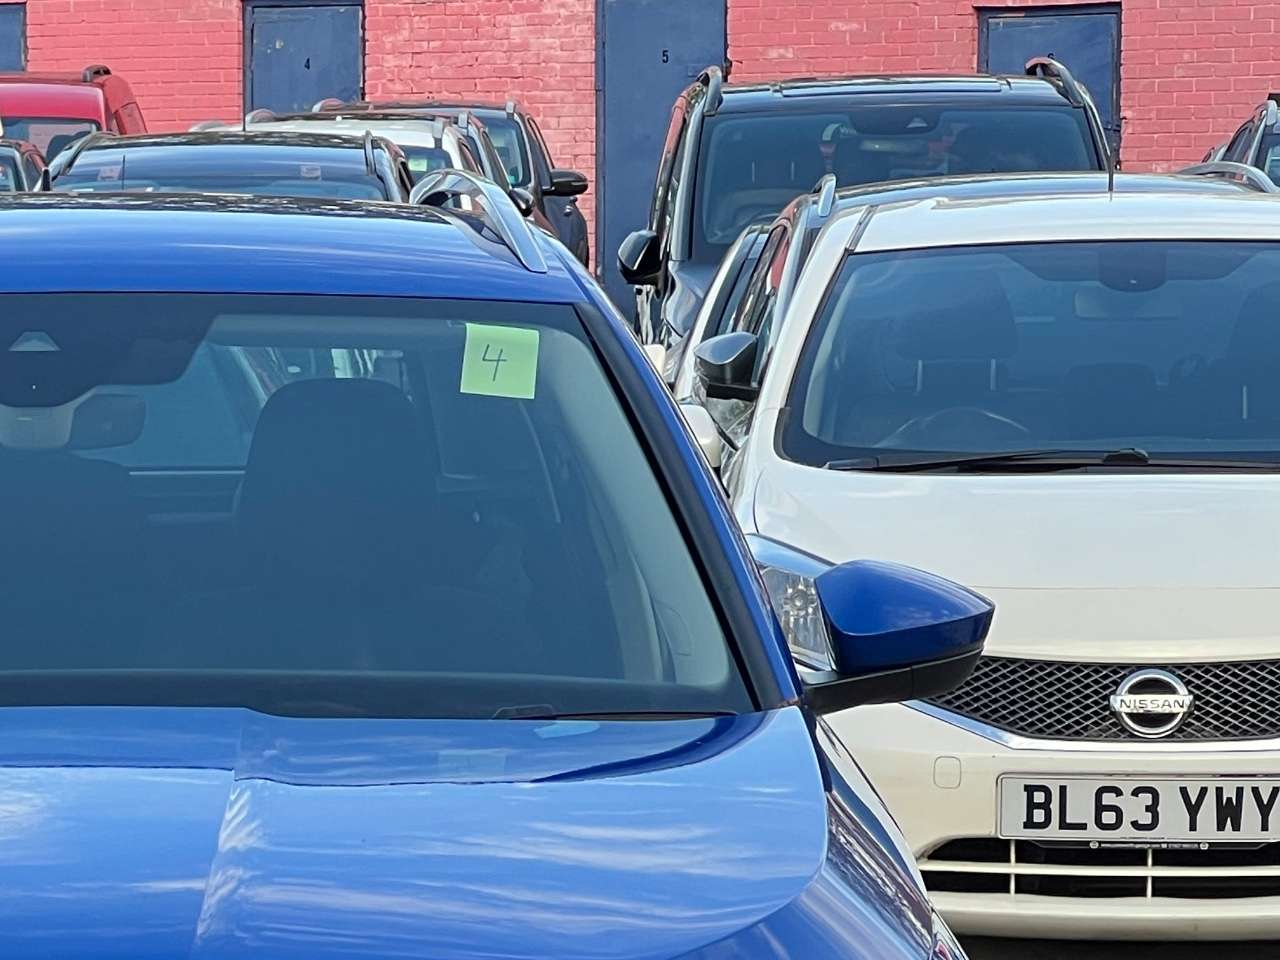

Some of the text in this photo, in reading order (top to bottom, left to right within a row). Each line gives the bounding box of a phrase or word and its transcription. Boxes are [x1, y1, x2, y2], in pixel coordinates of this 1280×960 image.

[304, 57, 310, 70] 4
[662, 49, 669, 64] 5
[482, 343, 508, 382] 4
[1120, 699, 1185, 709] NISSAN
[1023, 784, 1280, 832] BL63 YWY
